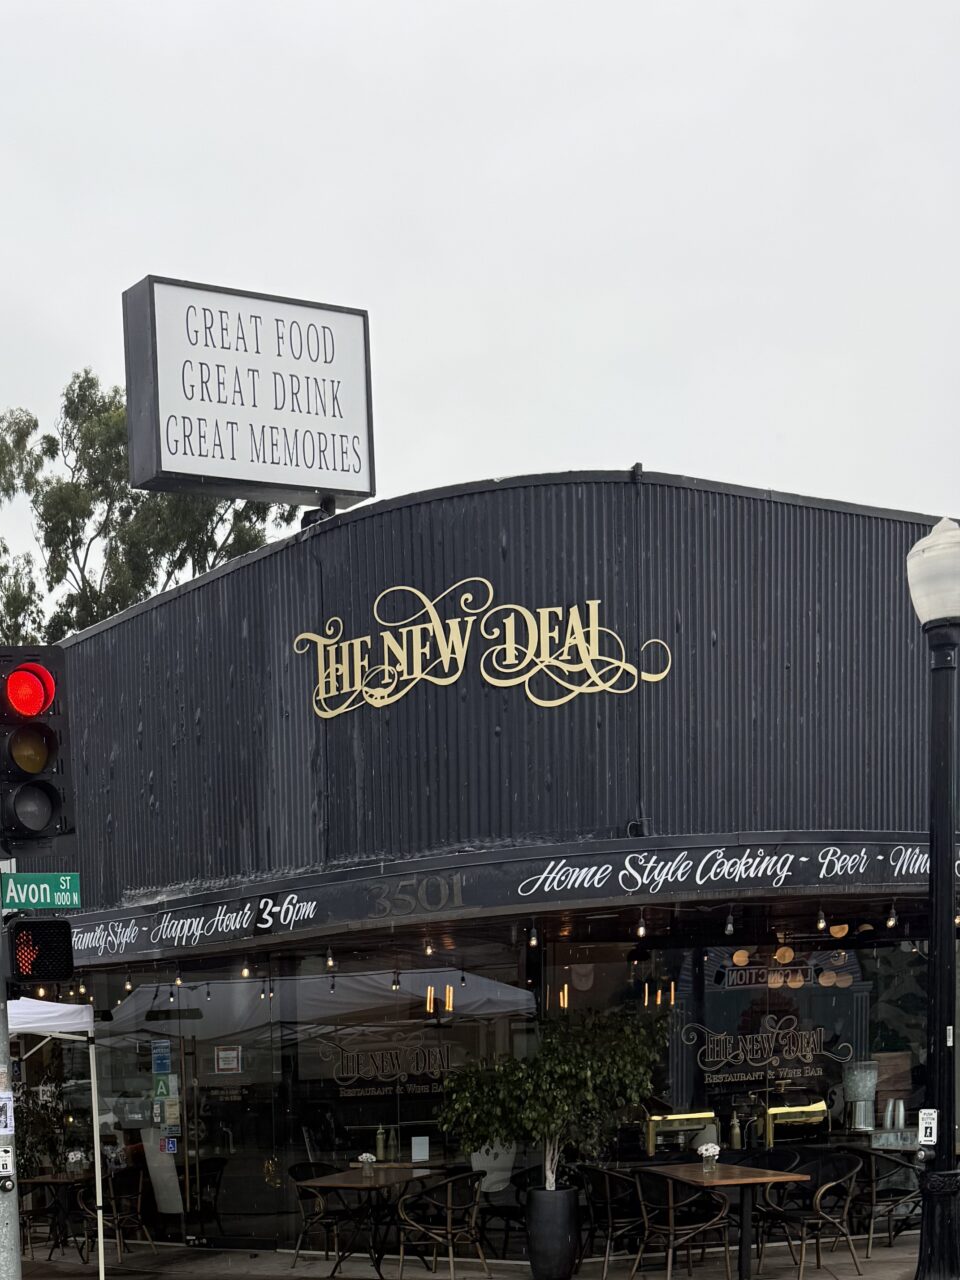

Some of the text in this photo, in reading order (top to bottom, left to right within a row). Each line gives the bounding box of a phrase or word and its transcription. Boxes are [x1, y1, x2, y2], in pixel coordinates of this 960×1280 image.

[186, 305, 335, 364] GREAT FOOD
[181, 359, 344, 419] GREAT DRINK
[166, 414, 362, 474] GREAT MEMORIES
[293, 616, 371, 718] THE
[480, 599, 646, 707] DEAL
[6, 876, 71, 904] Avon ST
[54, 892, 71, 905] 1000
[367, 871, 464, 919] 3501
[518, 859, 613, 896] Home
[618, 851, 693, 893] Style
[695, 847, 795, 887] Cooking
[818, 846, 872, 879] Beer
[889, 845, 930, 877] Win
[107, 919, 139, 954] Style
[150, 912, 204, 946] Happy
[204, 903, 255, 936] Hour
[256, 894, 317, 930] 3-6pm
